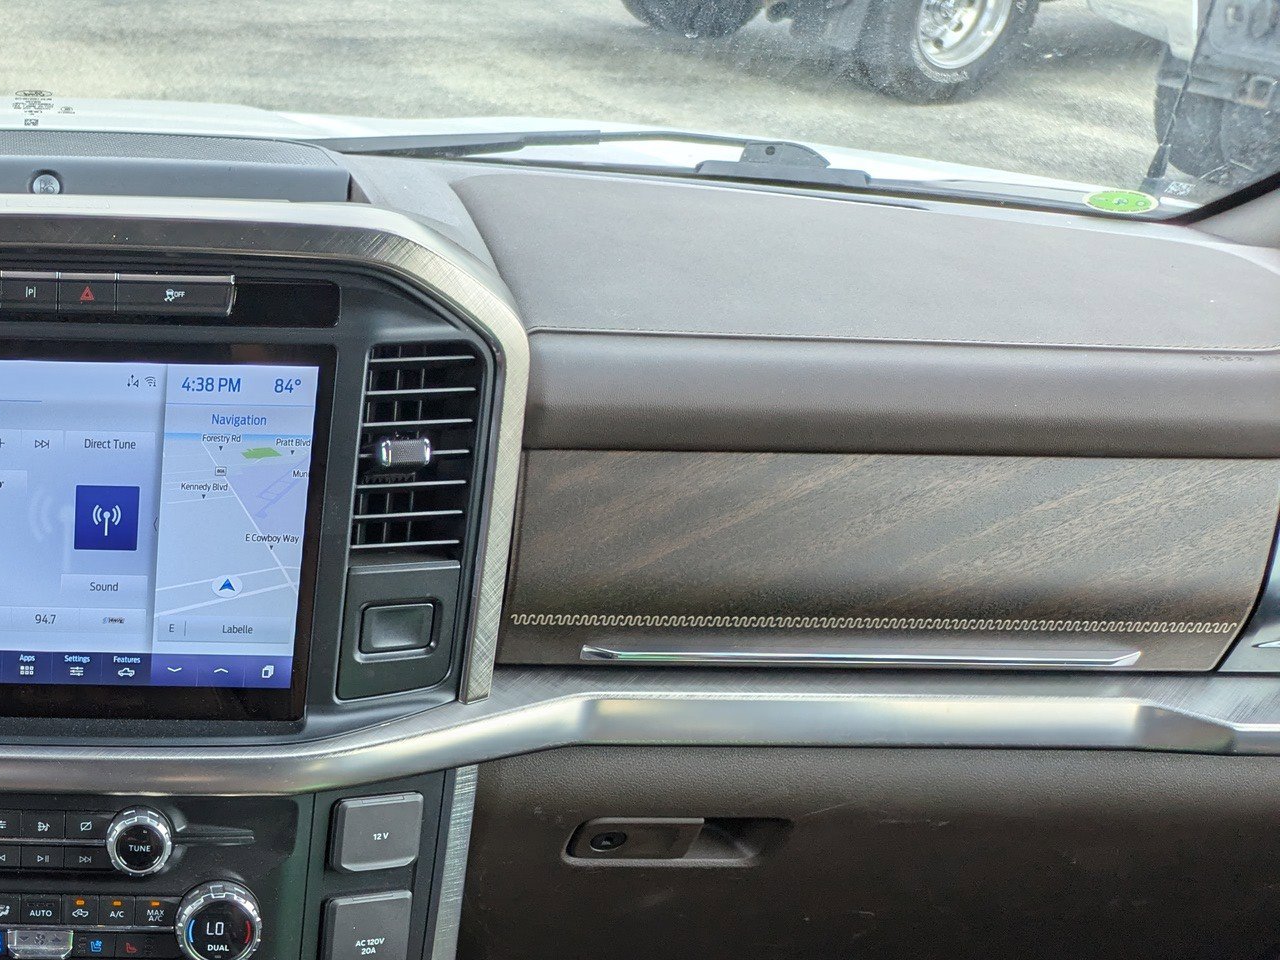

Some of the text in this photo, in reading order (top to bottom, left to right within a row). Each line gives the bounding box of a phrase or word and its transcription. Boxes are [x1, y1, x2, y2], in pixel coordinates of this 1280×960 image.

[173, 290, 185, 298] OFF
[181, 377, 241, 393] 4:38 PM
[211, 413, 267, 427] Navigation
[84, 438, 136, 450] Direct Tune
[202, 434, 241, 444] Forestry Rd
[276, 438, 293, 447] Pratt
[180, 482, 228, 492] Kennedy Blvd
[245, 533, 300, 545] E Cowboy Way
[89, 581, 119, 592] Sound
[35, 614, 56, 624] 94.7
[169, 624, 175, 632] E
[222, 624, 253, 634] Labelle
[19, 654, 36, 663] Apps
[64, 655, 90, 664] Settings
[113, 655, 141, 664] Features
[383, 832, 389, 840] V
[109, 910, 125, 918] A/C
[206, 921, 224, 936] LO
[355, 937, 385, 947] AC 120V
[207, 944, 229, 952] DUAL
[361, 947, 376, 955] 20A
